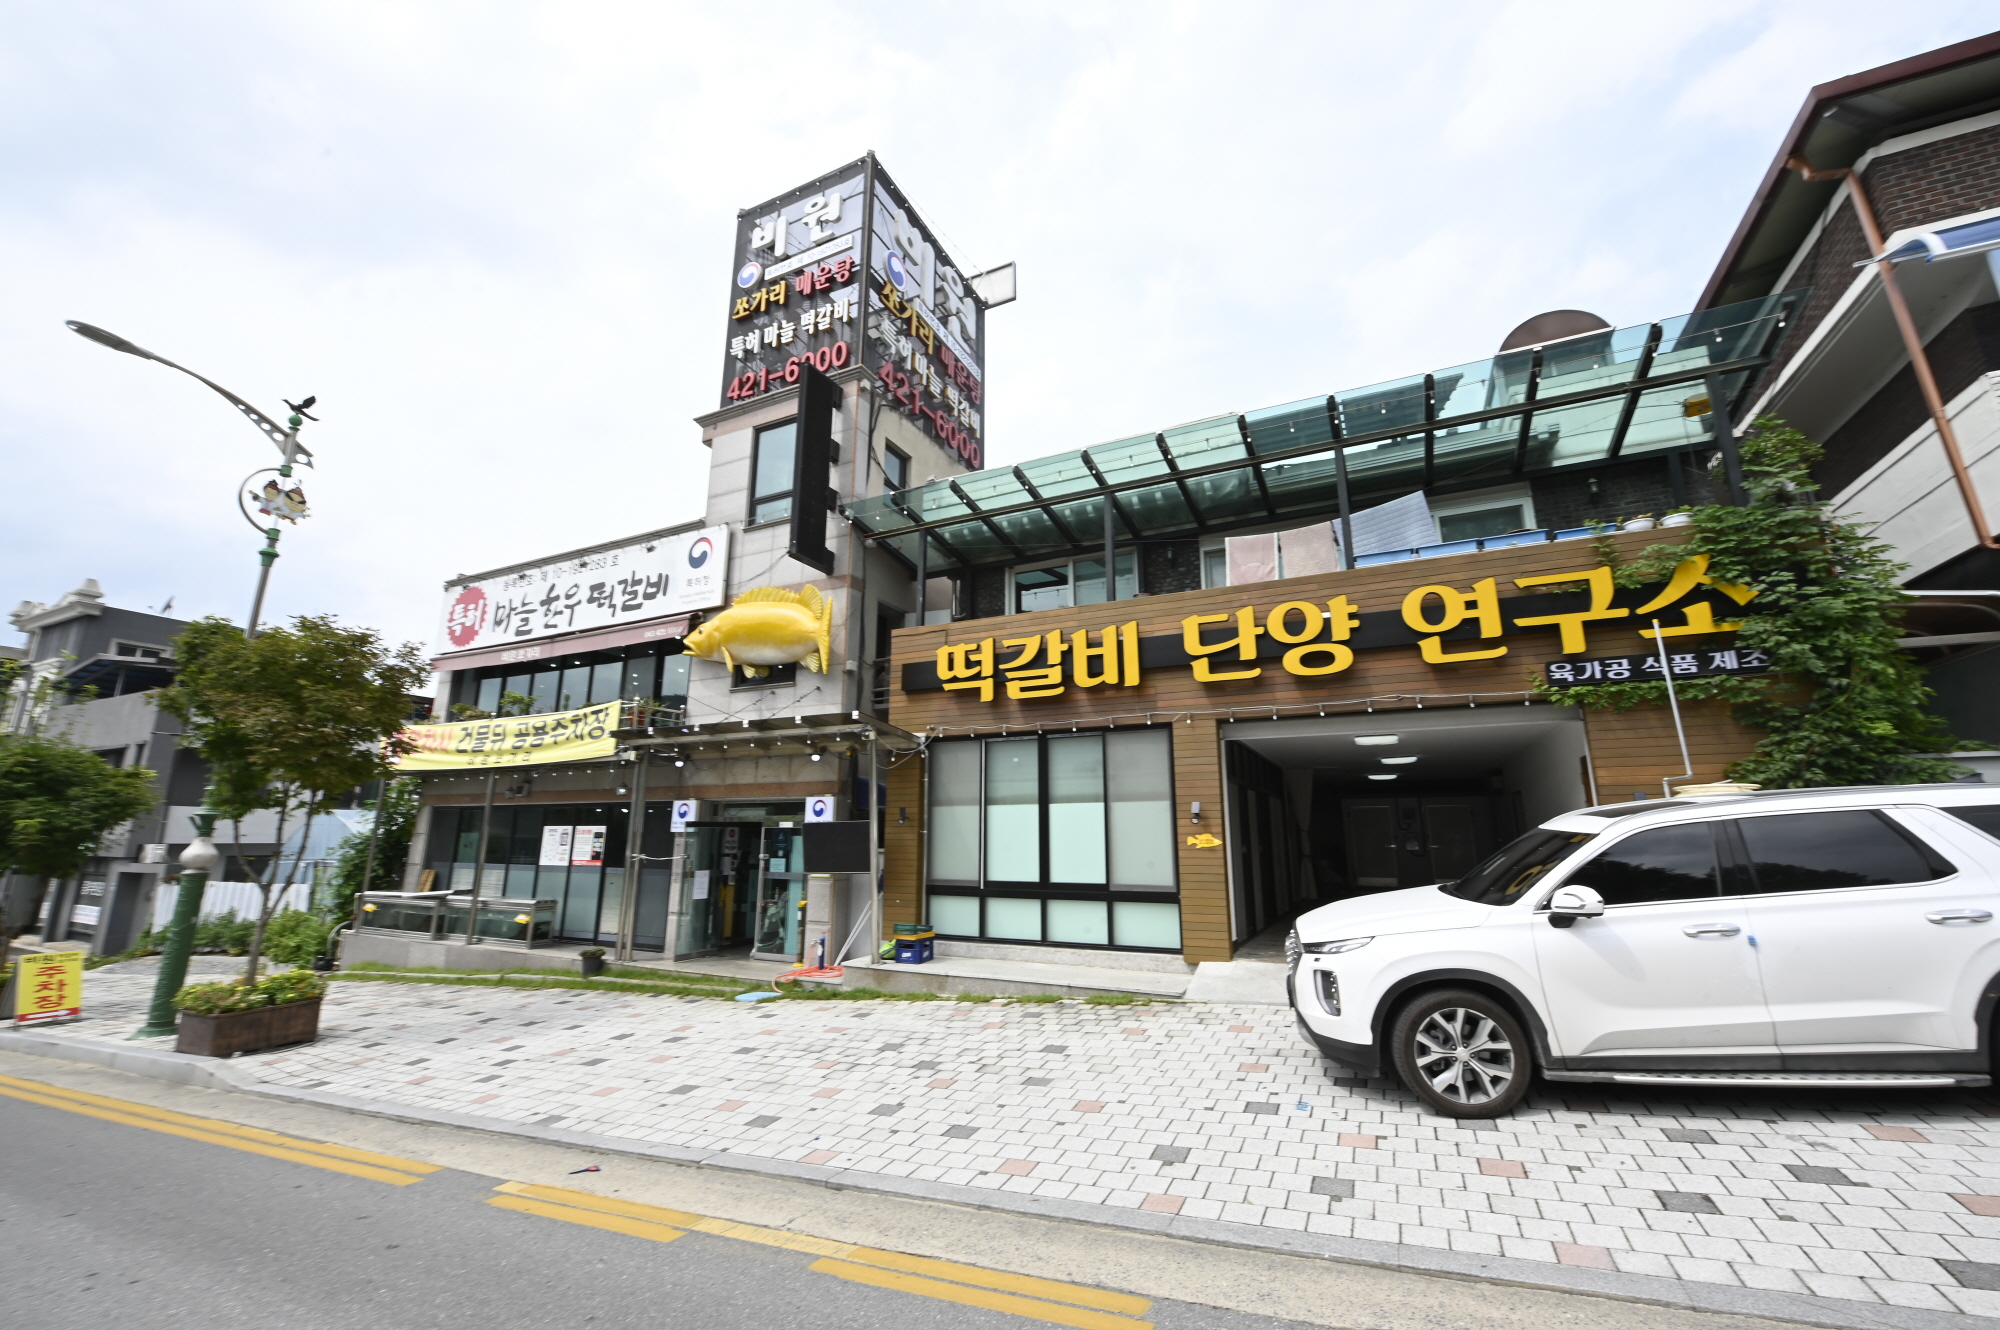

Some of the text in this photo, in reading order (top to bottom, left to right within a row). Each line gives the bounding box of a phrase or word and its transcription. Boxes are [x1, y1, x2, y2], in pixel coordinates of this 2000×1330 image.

[750, 192, 844, 260] 비원
[731, 255, 856, 321] 쏘가리 매운탕
[894, 208, 977, 354] 비원
[730, 298, 852, 359] 특허 마늘 떡갈비
[880, 281, 935, 354] 쏘가리
[938, 344, 982, 406] 매운탕
[879, 318, 913, 370] 특허
[913, 351, 942, 400] 마늘
[943, 384, 981, 438] 떡갈비
[878, 361, 981, 469] 421-6000
[447, 570, 669, 637] 특허 마늘 한우 떡갈비
[936, 554, 1759, 702] 떡갈비 단양 연구소
[1549, 649, 1769, 682] 육가공 식품 제조
[513, 707, 610, 750] 공용주차장
[33, 965, 68, 1009] 주차장
